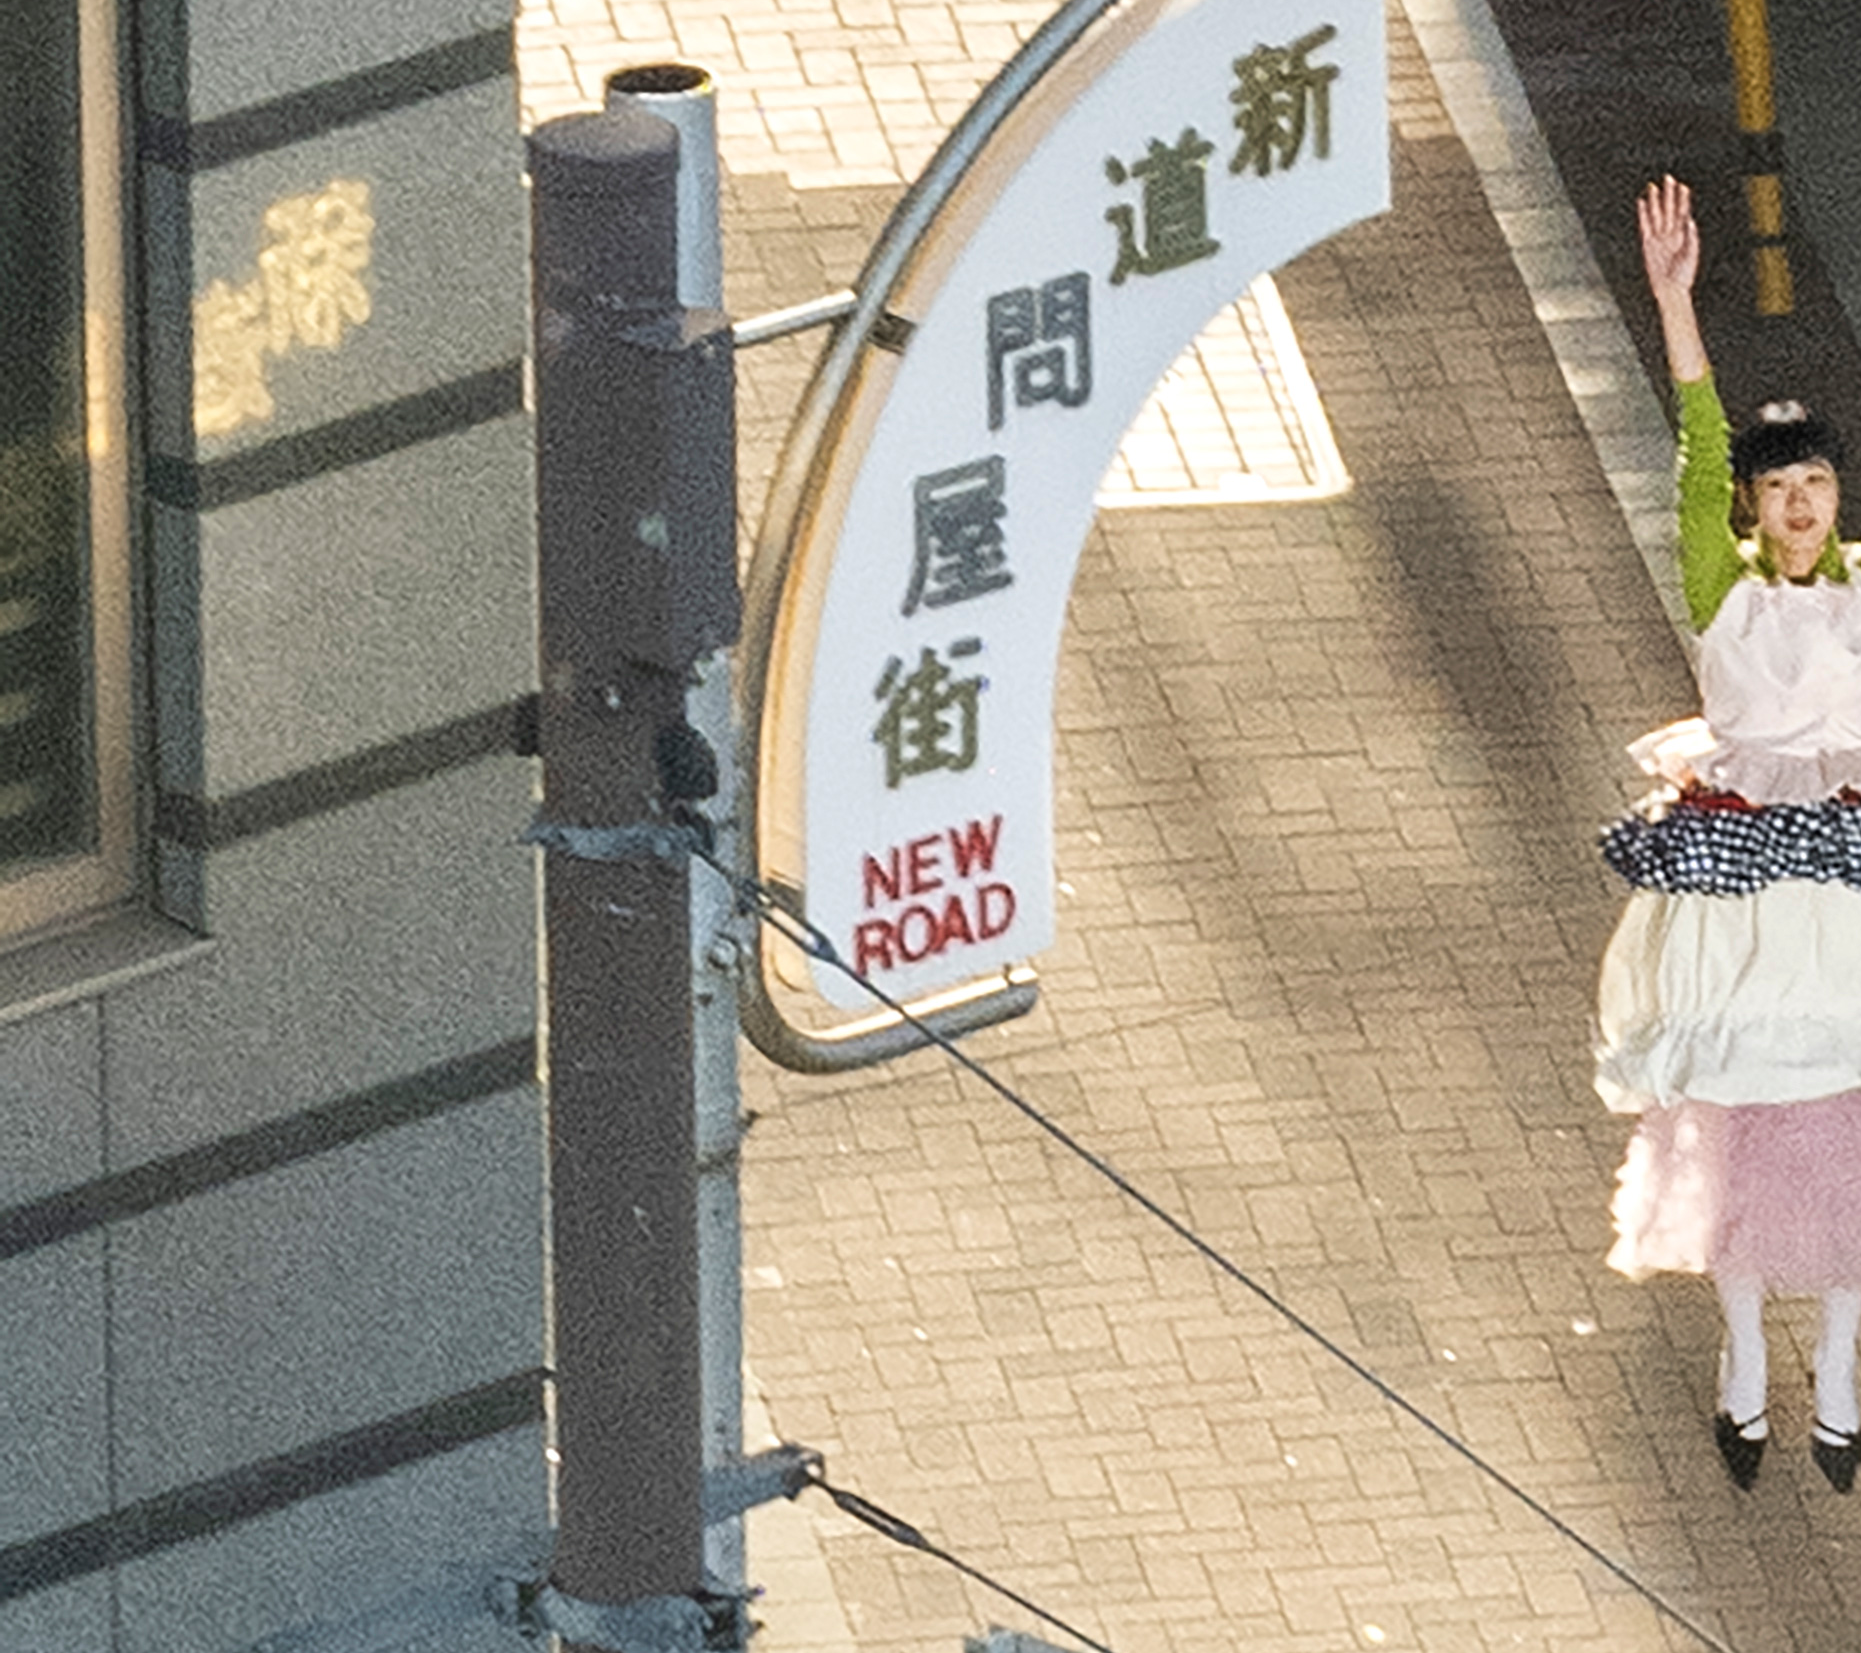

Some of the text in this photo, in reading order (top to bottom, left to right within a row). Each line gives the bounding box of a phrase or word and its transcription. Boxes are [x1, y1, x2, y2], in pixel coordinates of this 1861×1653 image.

[872, 23, 1341, 789] 新道問屋街
[863, 813, 1004, 908] NEW
[854, 882, 1016, 977] ROAD
